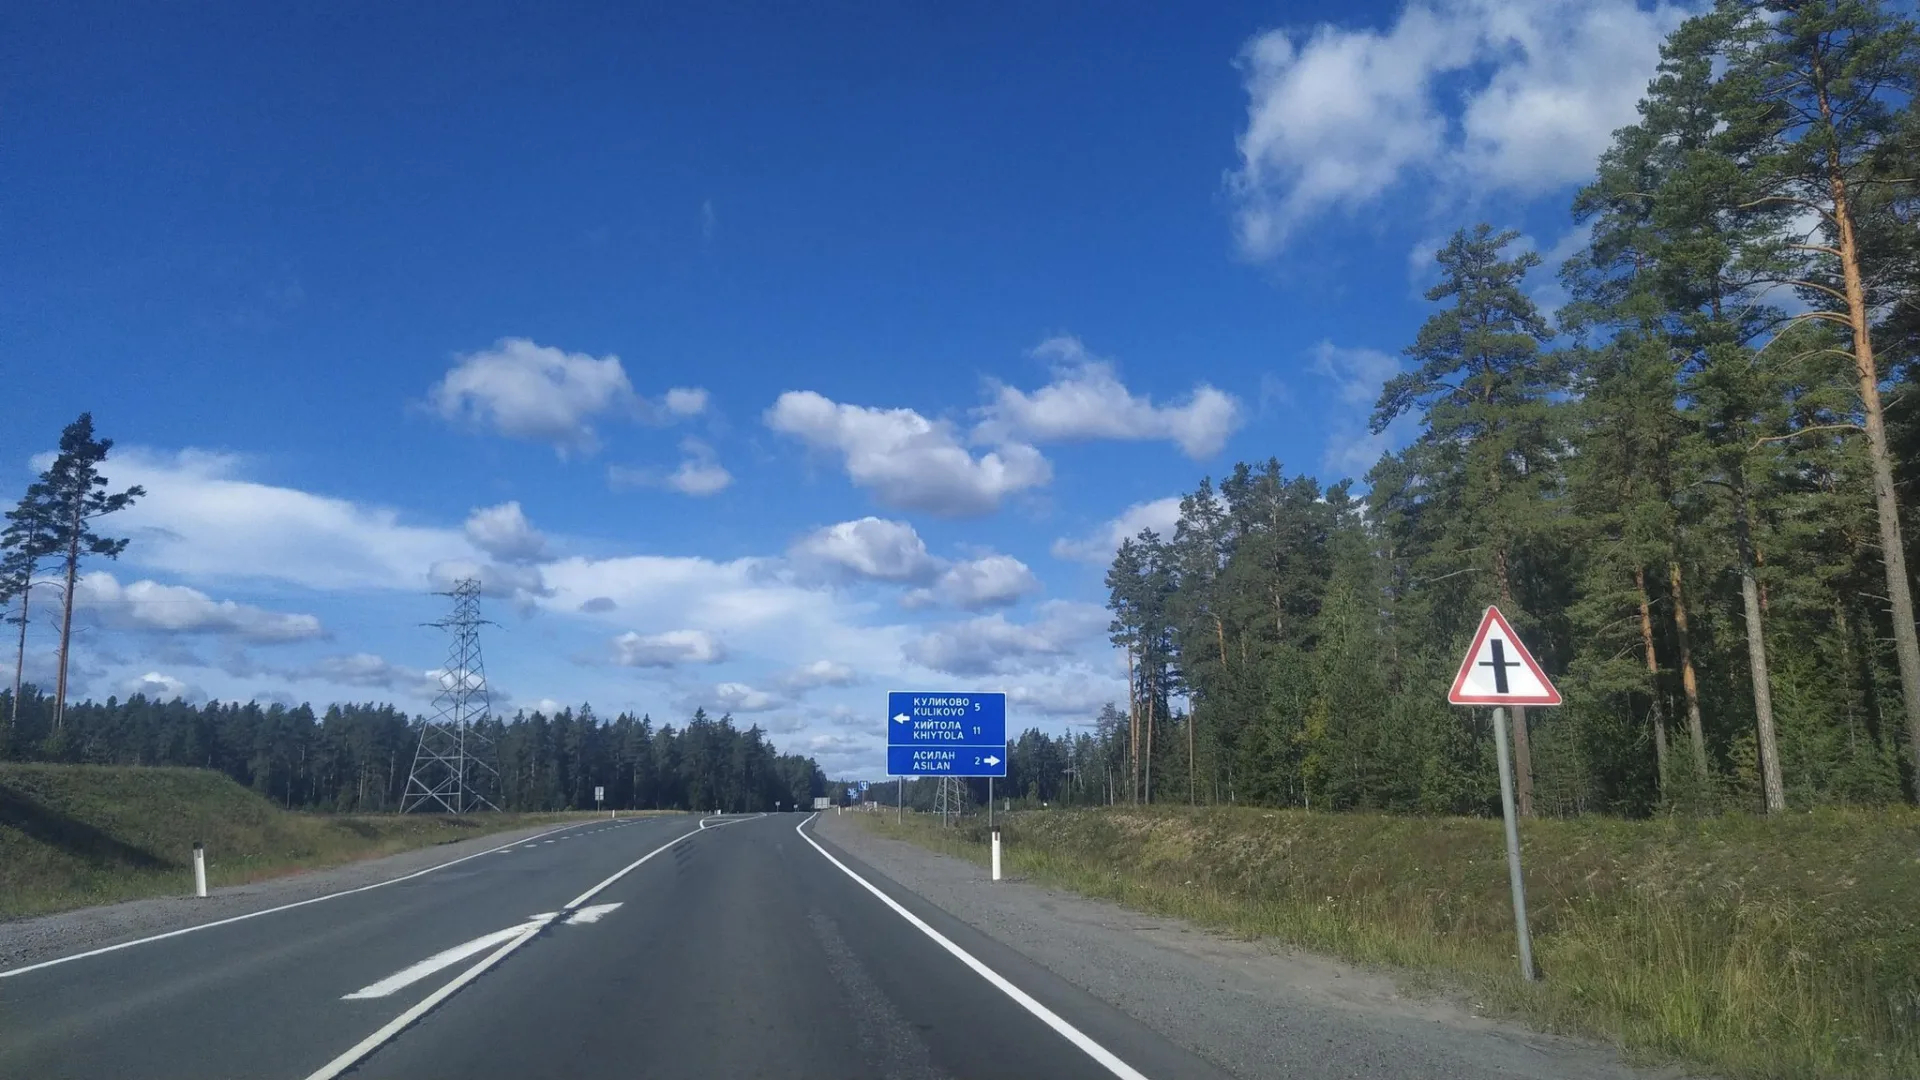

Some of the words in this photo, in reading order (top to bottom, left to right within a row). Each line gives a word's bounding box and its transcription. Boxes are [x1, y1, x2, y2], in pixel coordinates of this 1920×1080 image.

[913, 698, 970, 706] КУЛИКОВО
[974, 702, 981, 712] 5
[913, 708, 965, 716] KULIKOVO
[913, 719, 962, 729] ХИЙТОЛА
[973, 726, 981, 735] 11
[913, 731, 964, 739] KHIYTOLA
[913, 751, 955, 759] АСИЛАН
[974, 756, 981, 765] 2
[913, 762, 951, 770] ASILAN
